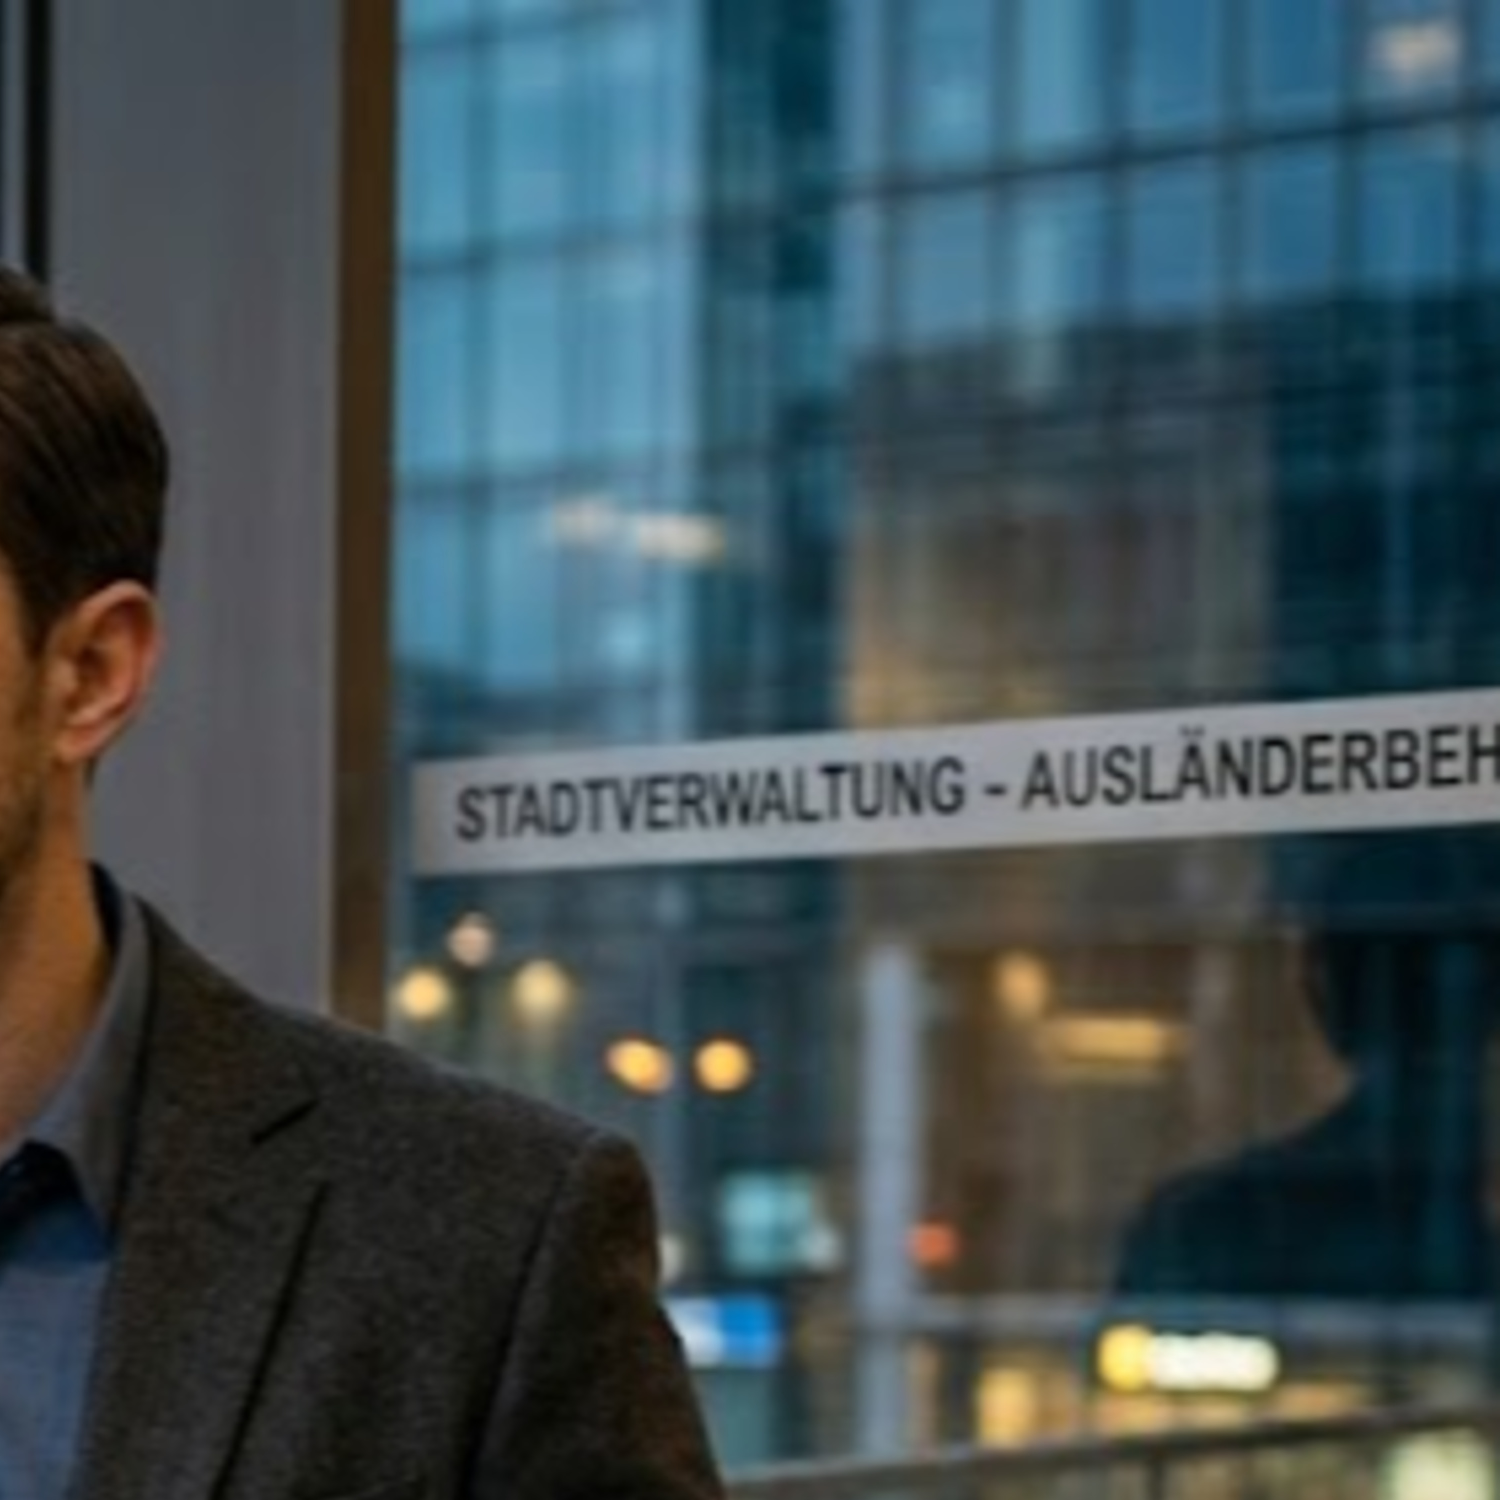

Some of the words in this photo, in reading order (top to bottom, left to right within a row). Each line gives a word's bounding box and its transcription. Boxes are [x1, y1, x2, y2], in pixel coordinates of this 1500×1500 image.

[456, 755, 965, 843] STADTVERWALTUNG
[984, 783, 1008, 797] -
[1020, 722, 1500, 811] AUSLÄNDERBEH
